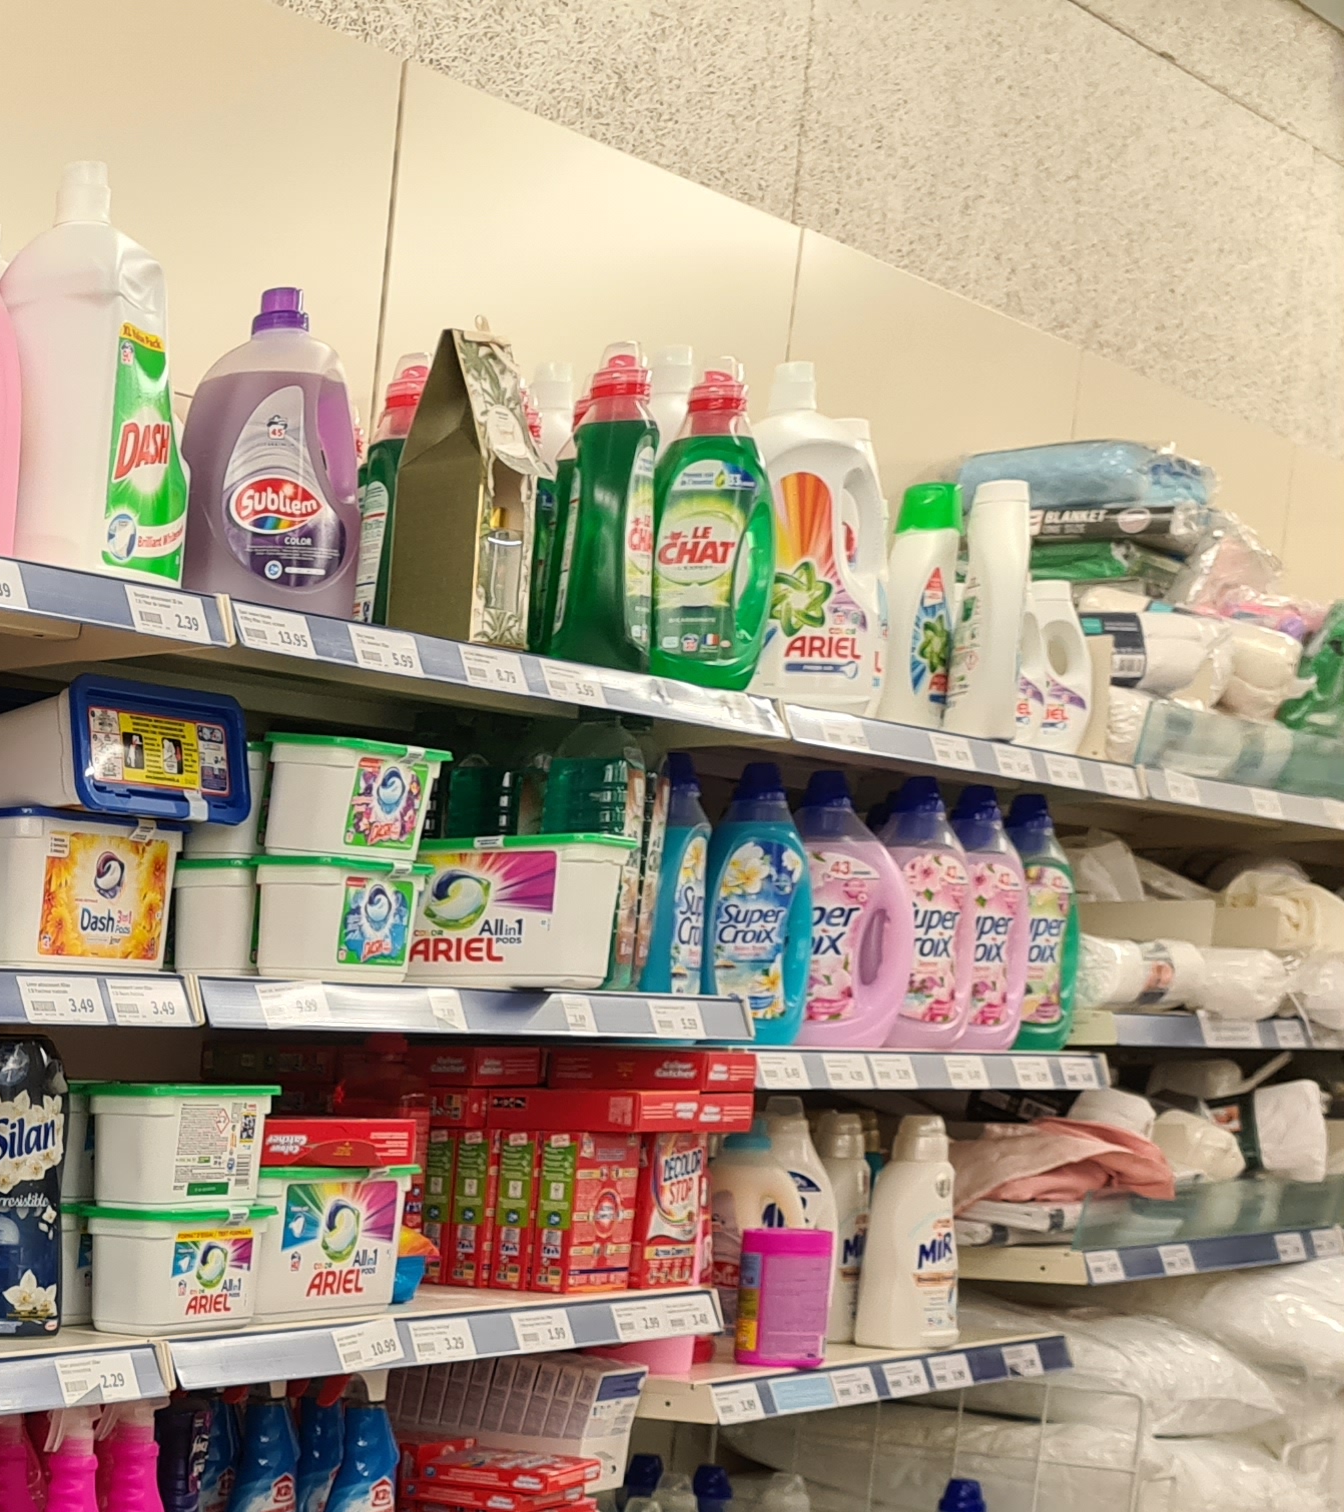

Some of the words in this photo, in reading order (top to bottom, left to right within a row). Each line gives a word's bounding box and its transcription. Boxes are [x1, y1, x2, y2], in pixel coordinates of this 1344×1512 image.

[113, 420, 171, 483] DASH
[241, 486, 318, 519] Subliem
[1043, 509, 1109, 525] BLANKET
[283, 536, 312, 547] COLOR
[691, 526, 712, 541] LE
[659, 538, 738, 566] CHAT
[277, 629, 309, 649] 13.95
[784, 636, 862, 660] ARIEL
[79, 906, 115, 934] Dash
[721, 904, 786, 926] Super
[716, 920, 776, 947] Croix
[408, 939, 504, 963] ARIEL
